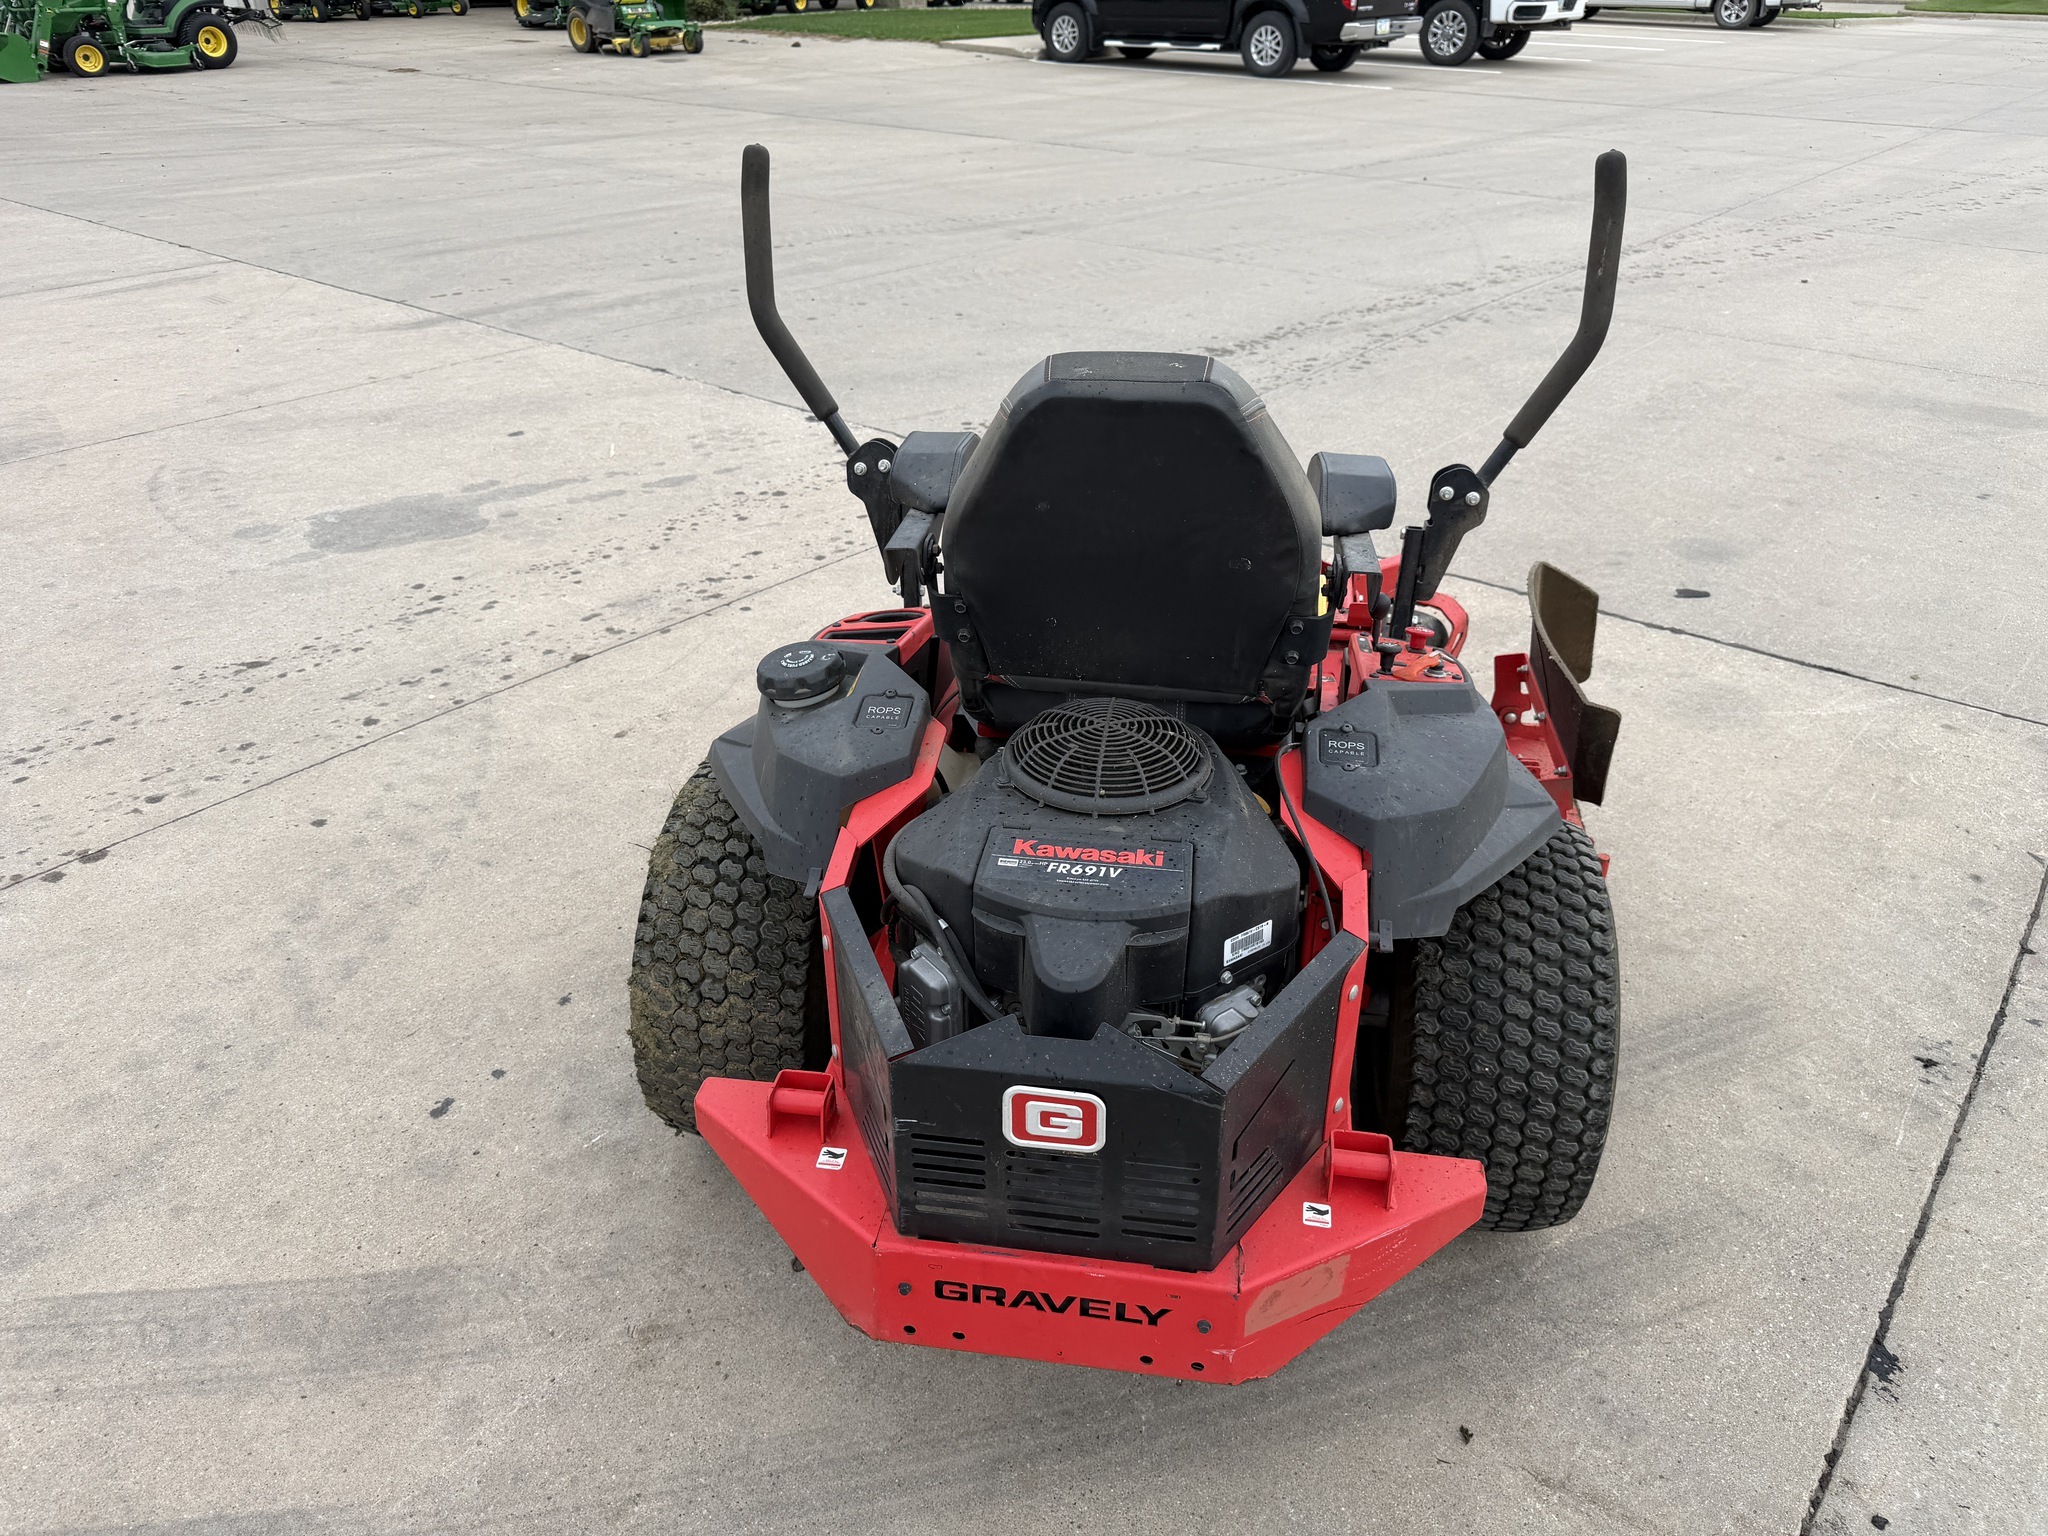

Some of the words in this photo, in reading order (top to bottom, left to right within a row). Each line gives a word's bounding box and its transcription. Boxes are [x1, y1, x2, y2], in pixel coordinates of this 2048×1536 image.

[867, 706, 902, 715] ROPS
[1328, 740, 1365, 750] ROPS
[1328, 748, 1365, 756] CAPABLE
[1013, 839, 1164, 866] Kawasaki
[1046, 862, 1123, 878] FR691V
[1025, 1100, 1083, 1140] G
[934, 1279, 1173, 1327] GRAVELY
